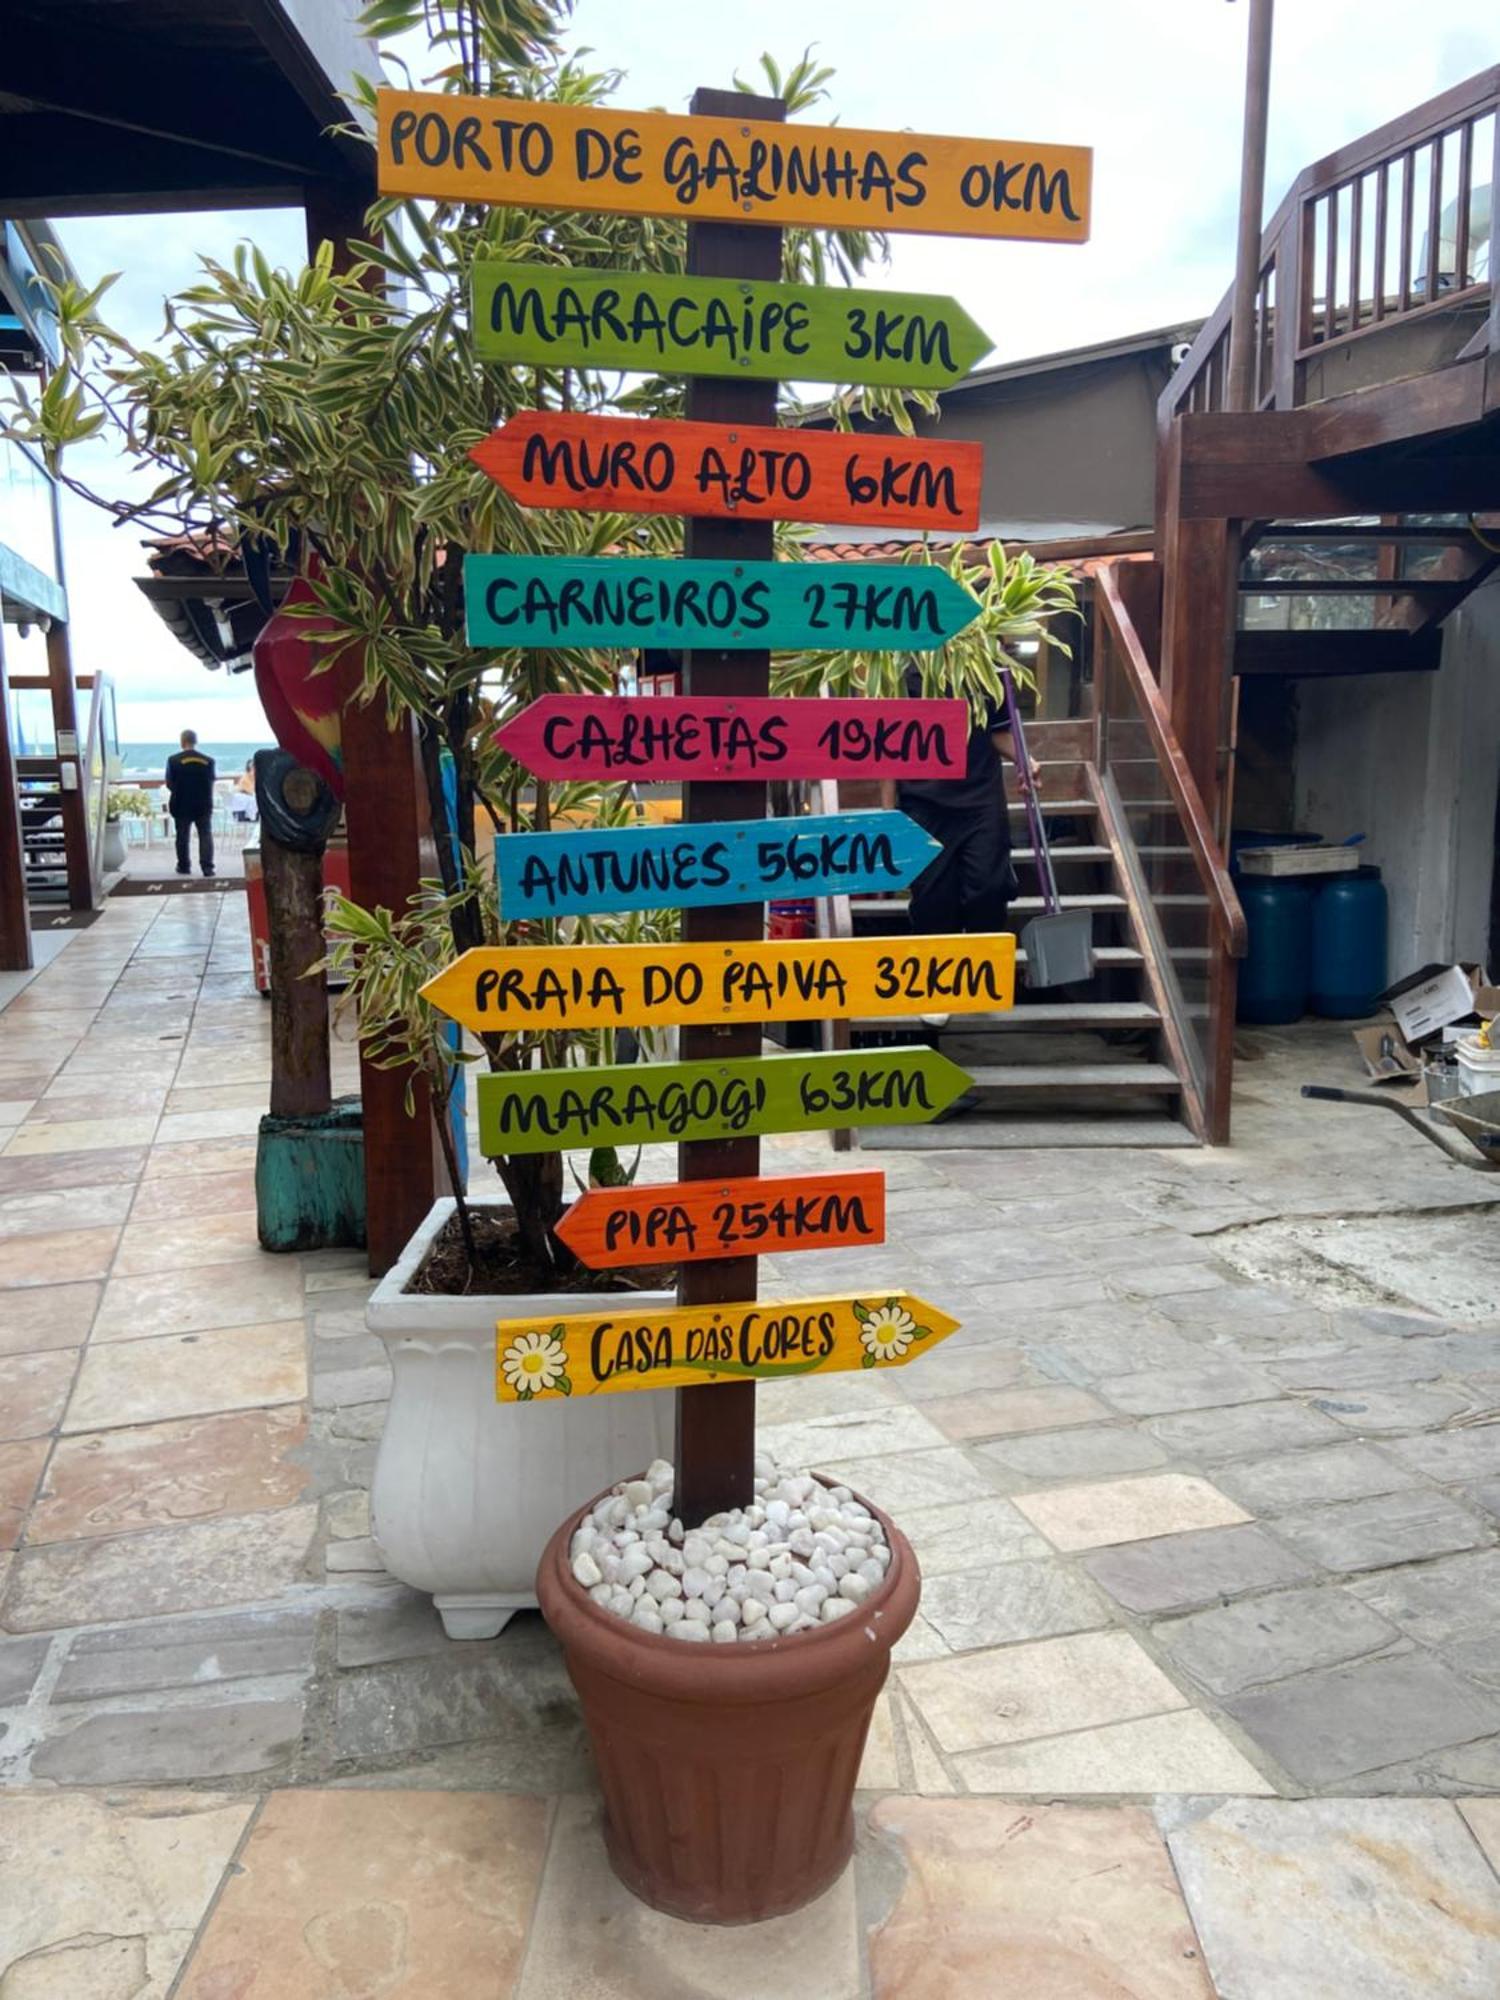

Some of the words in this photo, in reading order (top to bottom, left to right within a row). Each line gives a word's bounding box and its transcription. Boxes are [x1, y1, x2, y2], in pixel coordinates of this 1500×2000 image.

[391, 112, 552, 176] PORTO
[576, 129, 641, 183] DE
[664, 137, 926, 212] GALINHAS
[961, 162, 1079, 221] 0KM
[844, 309, 958, 373] 3KM
[523, 434, 674, 492] MURO
[696, 448, 810, 505] ALTO
[846, 455, 961, 515] 6KM
[485, 573, 770, 637] CARNEIROS
[803, 582, 946, 635] 27KM
[544, 714, 787, 768] CALHETAS
[818, 719, 952, 766] 19KM
[518, 841, 730, 905] ANTUNES
[758, 834, 901, 882] 56KM
[476, 968, 624, 1015] PRAIA
[644, 963, 702, 1006] DO
[723, 960, 846, 1008] PAIVA
[876, 957, 1001, 1000] 32KM
[500, 1078, 766, 1136] MARAGOGI
[800, 1069, 935, 1115] 63KM
[606, 1208, 696, 1251] PIPA
[713, 1196, 872, 1242] 254KM
[591, 1323, 674, 1382] CASA
[686, 1325, 733, 1362] DAS
[739, 1312, 834, 1365] CORES
